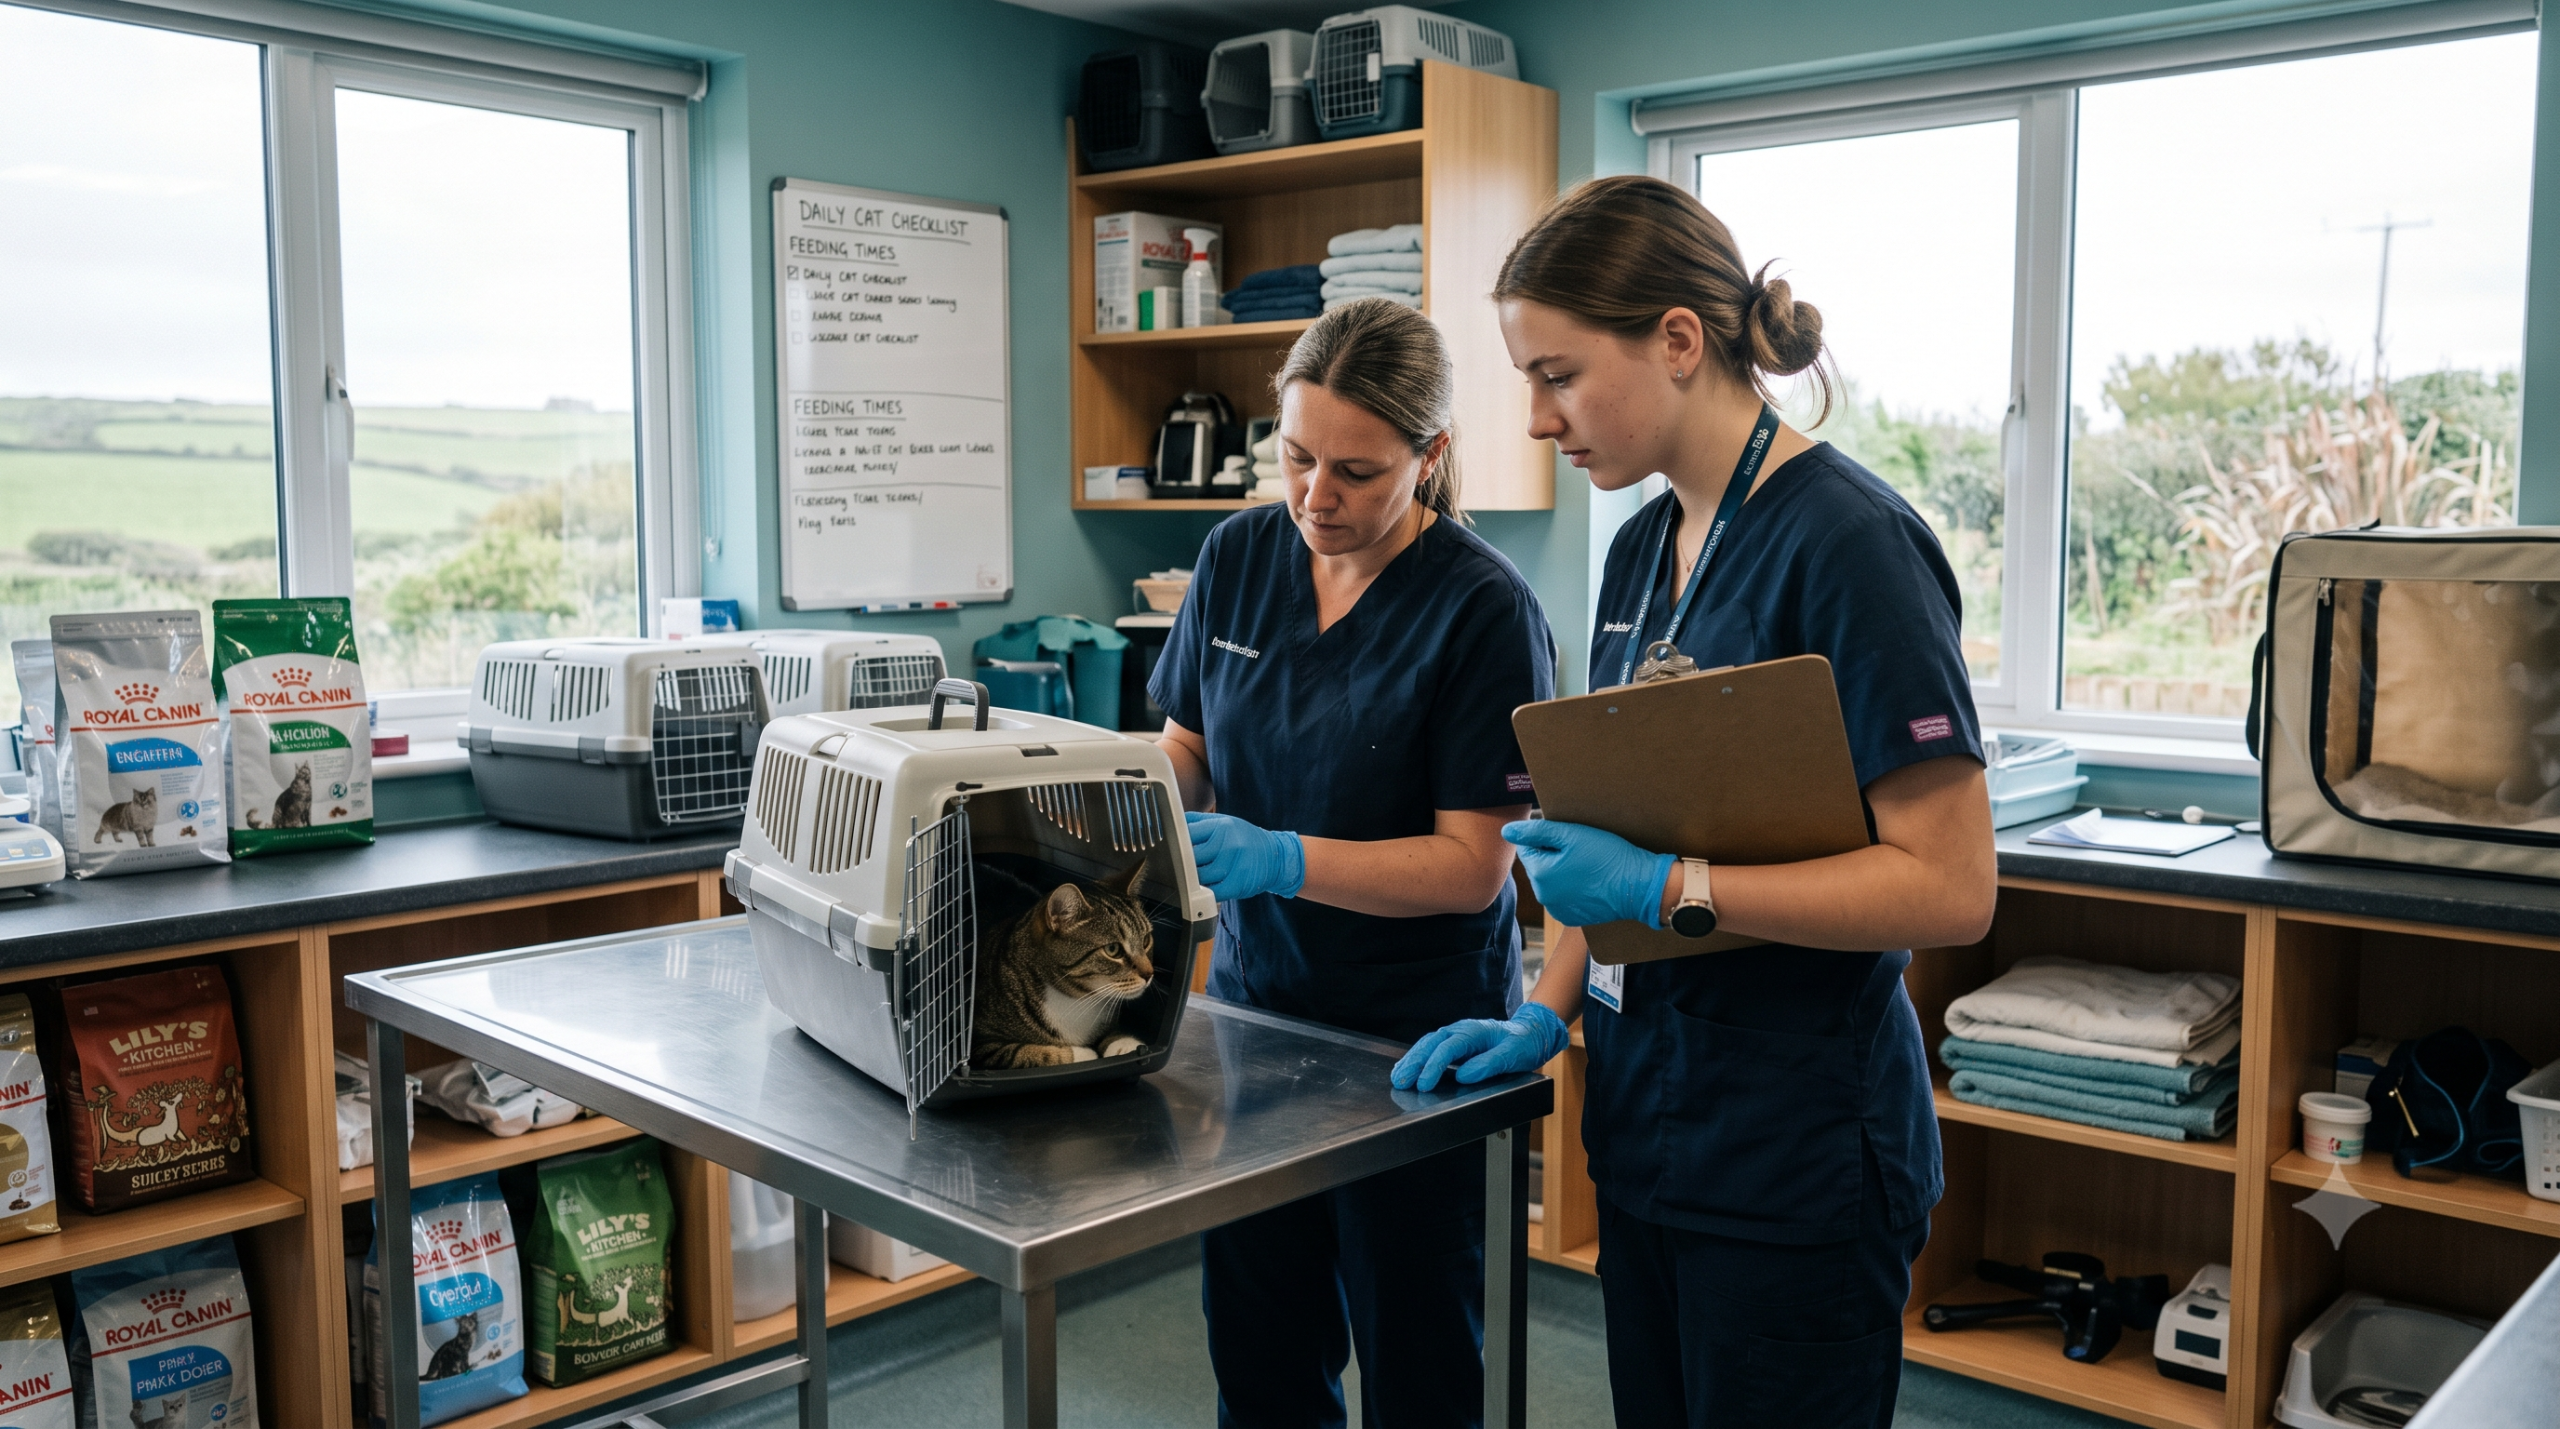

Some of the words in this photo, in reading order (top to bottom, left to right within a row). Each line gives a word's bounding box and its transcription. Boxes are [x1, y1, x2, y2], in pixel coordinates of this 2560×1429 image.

[799, 199, 846, 226] DAILY
[854, 207, 884, 228] CAT
[892, 211, 969, 237] CHECKLIST
[789, 235, 849, 259] FEEDING
[855, 243, 897, 260] TIMES
[839, 270, 858, 284] CAT
[794, 398, 855, 416] FEEDING
[863, 400, 903, 415] TIMES
[243, 692, 296, 707] ROYAL
[299, 687, 353, 704] CANIN
[83, 705, 140, 725] ROYAL
[143, 703, 202, 721] CANIN
[109, 1020, 209, 1056] LILY'S
[129, 1040, 195, 1064] KITCHEN
[577, 1212, 650, 1246] LILY'S
[590, 1230, 642, 1253] KITCHEN
[413, 1249, 447, 1269] OYAL
[449, 1230, 502, 1258] CANIN
[105, 1317, 168, 1346] ROYAL
[171, 1297, 233, 1329] CANIN
[0, 1373, 51, 1405] ANIN
